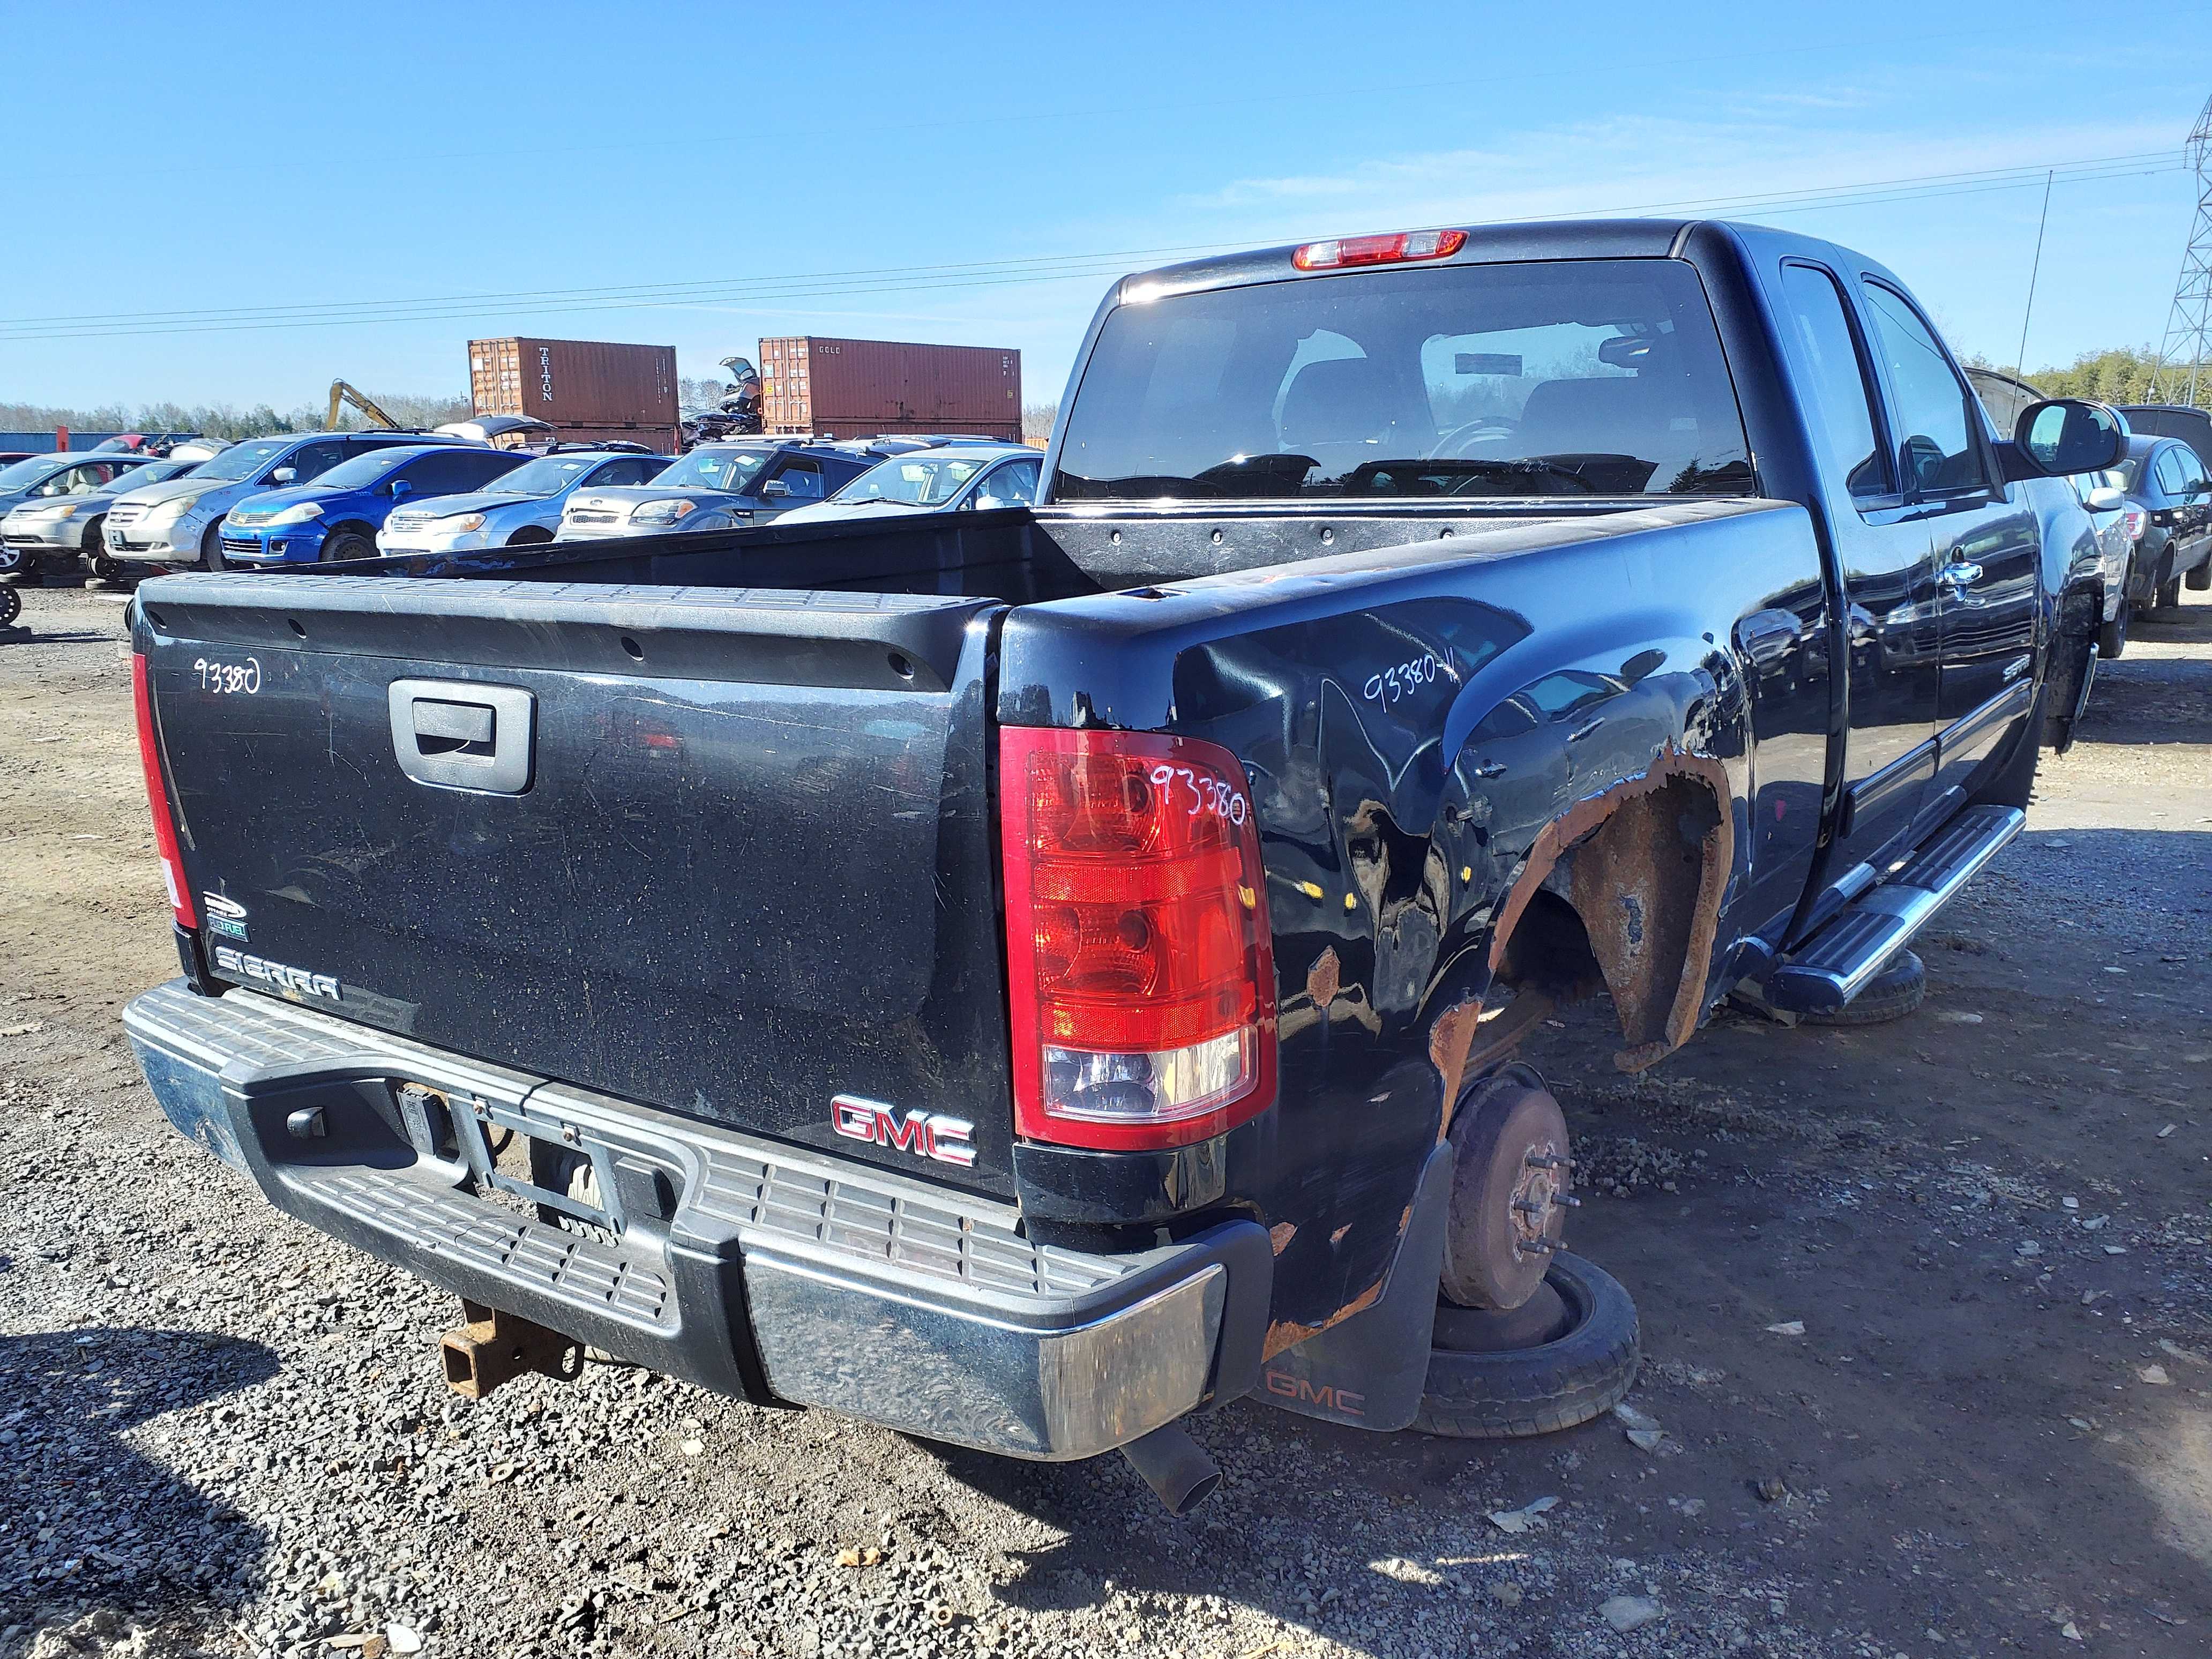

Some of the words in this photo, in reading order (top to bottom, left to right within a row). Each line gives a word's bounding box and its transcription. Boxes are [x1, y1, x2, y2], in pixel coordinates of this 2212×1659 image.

[539, 347, 552, 401] TRITON
[193, 656, 261, 694] 93380
[1150, 765, 1246, 826] 93380
[215, 946, 343, 1000] SIERRA
[831, 1094, 978, 1168] GMC
[1266, 1370, 1365, 1416] GMC
